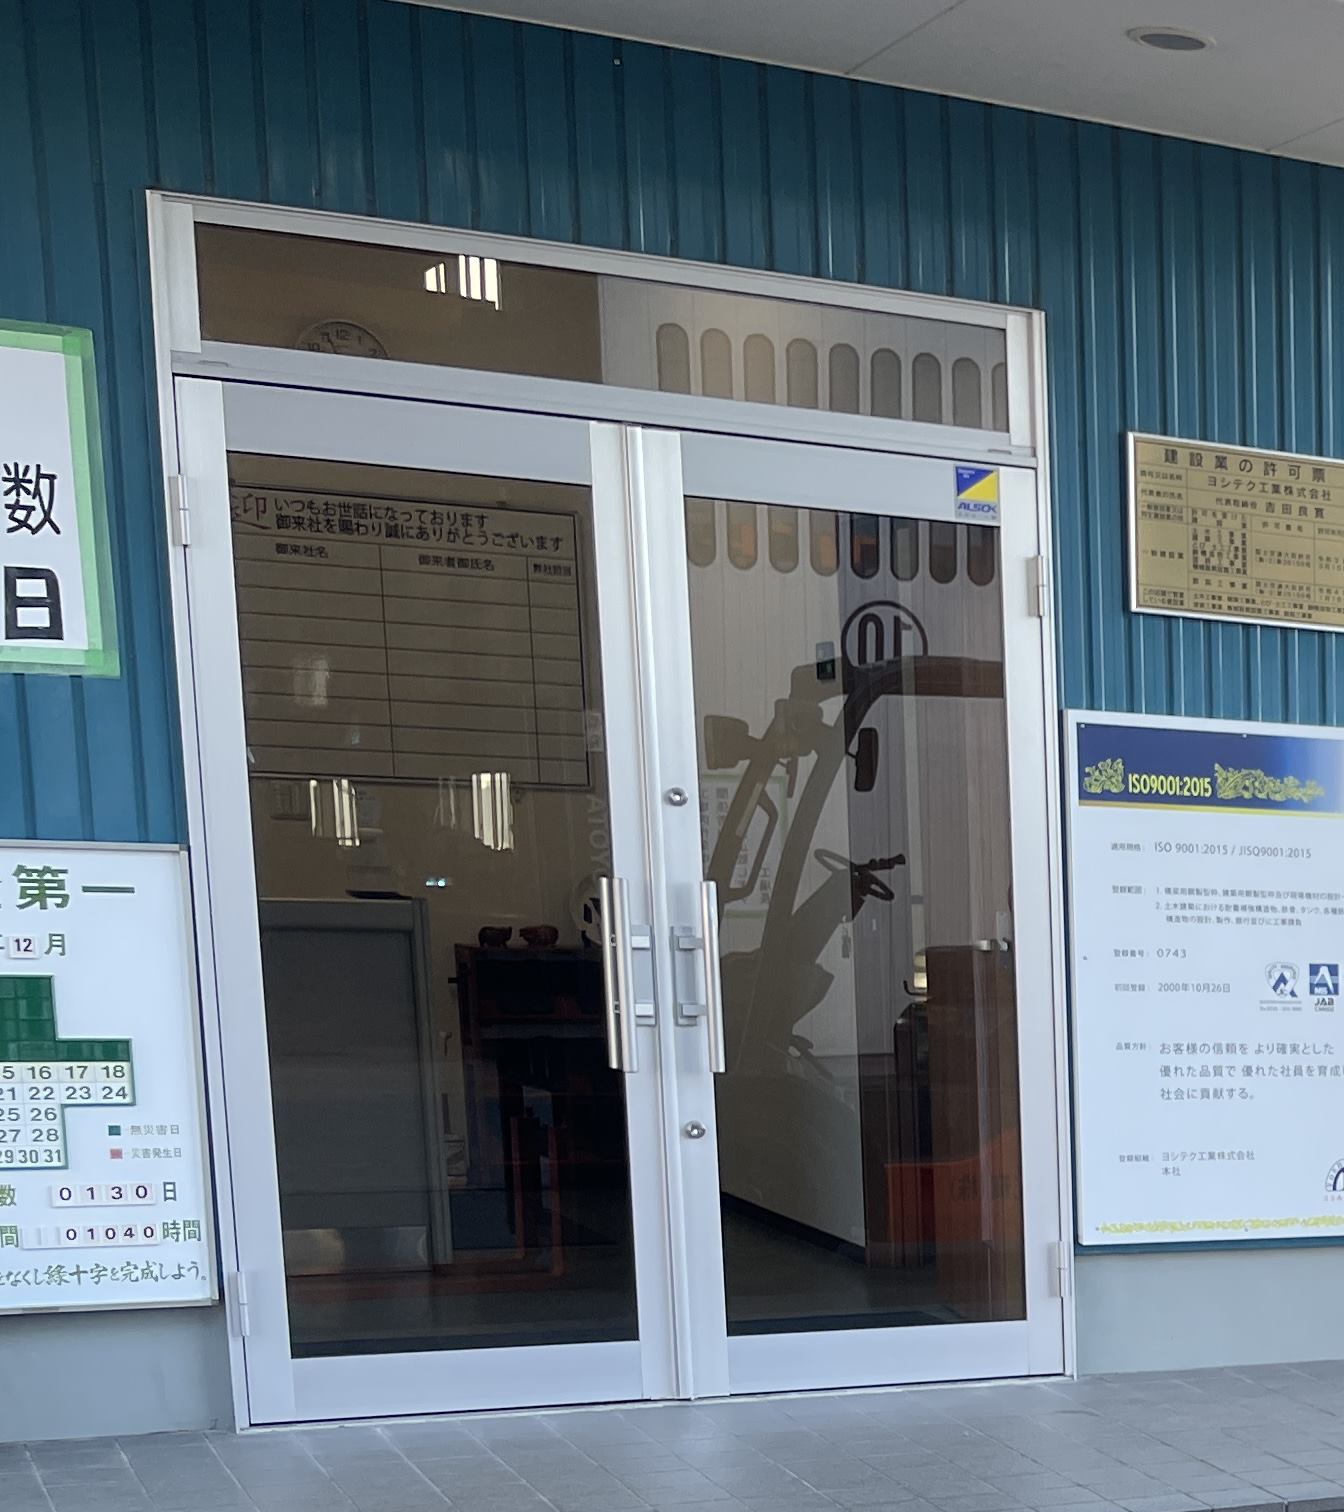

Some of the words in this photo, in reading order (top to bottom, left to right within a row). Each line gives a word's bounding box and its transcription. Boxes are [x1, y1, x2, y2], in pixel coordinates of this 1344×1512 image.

[1164, 448, 1326, 483] 建設業の許可票
[1208, 475, 1332, 502] ヨシテク工業株式会社
[1, 462, 61, 534] 数
[275, 500, 489, 528] いつもお世話になっております
[3, 566, 64, 640] 日
[1128, 774, 1212, 798] ISO9001:2015
[1155, 841, 1172, 853] ISO
[1175, 843, 1228, 855] 9001:2015
[1239, 846, 1311, 859] JISQ9001:2015
[0, 865, 135, 910] 第一
[1156, 949, 1187, 959] 0743
[1157, 982, 1231, 994] 2000年10月26日
[1314, 997, 1334, 1007] JAB
[1160, 1042, 1248, 1056] お客様の信頼を
[1253, 1042, 1335, 1056] より確実とした
[27, 1066, 52, 1080] 16
[65, 1066, 88, 1080] 17
[101, 1065, 125, 1079] 18
[1160, 1064, 1236, 1078] 優れた品質で
[29, 1086, 55, 1100] 22
[66, 1086, 91, 1100] 23
[102, 1086, 127, 1100] 24
[1160, 1087, 1255, 1101] 社会に貢献する。
[30, 1108, 57, 1122] 26
[32, 1129, 59, 1142] 28
[18, 1150, 39, 1163] 30
[44, 1150, 62, 1163] 31
[1161, 1149, 1255, 1163] ヨシテク工業株式会社
[163, 1182, 177, 1202] 日
[162, 1220, 201, 1242] 時間
[0, 1260, 207, 1287] なくし緑十字を完成しよう。
